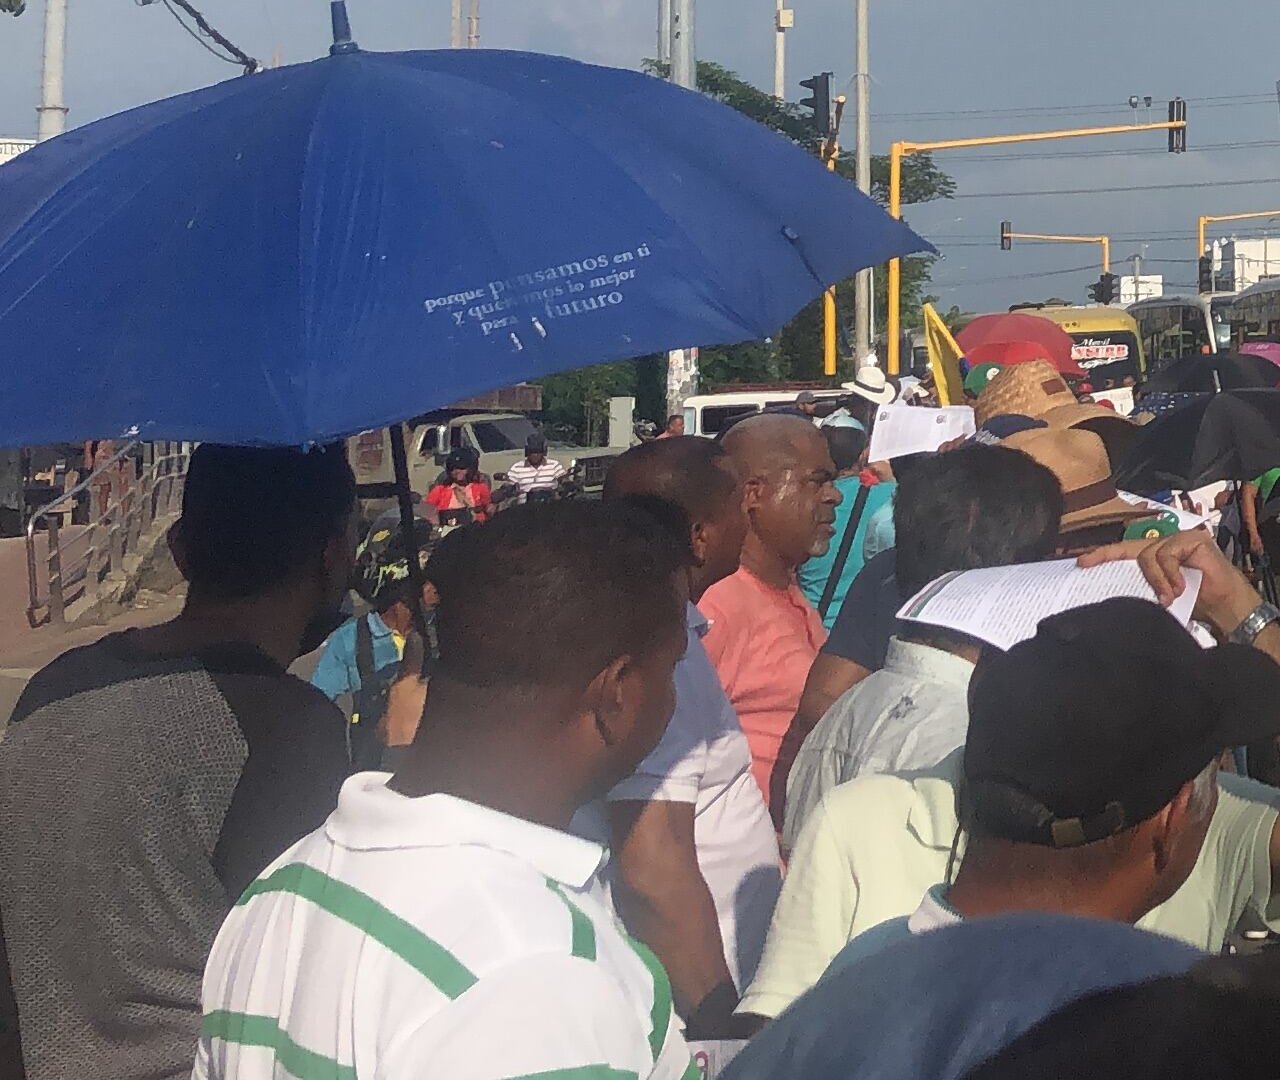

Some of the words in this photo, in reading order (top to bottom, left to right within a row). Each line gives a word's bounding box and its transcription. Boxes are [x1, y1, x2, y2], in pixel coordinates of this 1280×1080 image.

[424, 287, 486, 313] porque
[488, 254, 609, 299] pnsamos
[613, 251, 634, 264] en
[452, 309, 465, 325] y
[568, 279, 585, 294] lo
[589, 268, 637, 289] mejor
